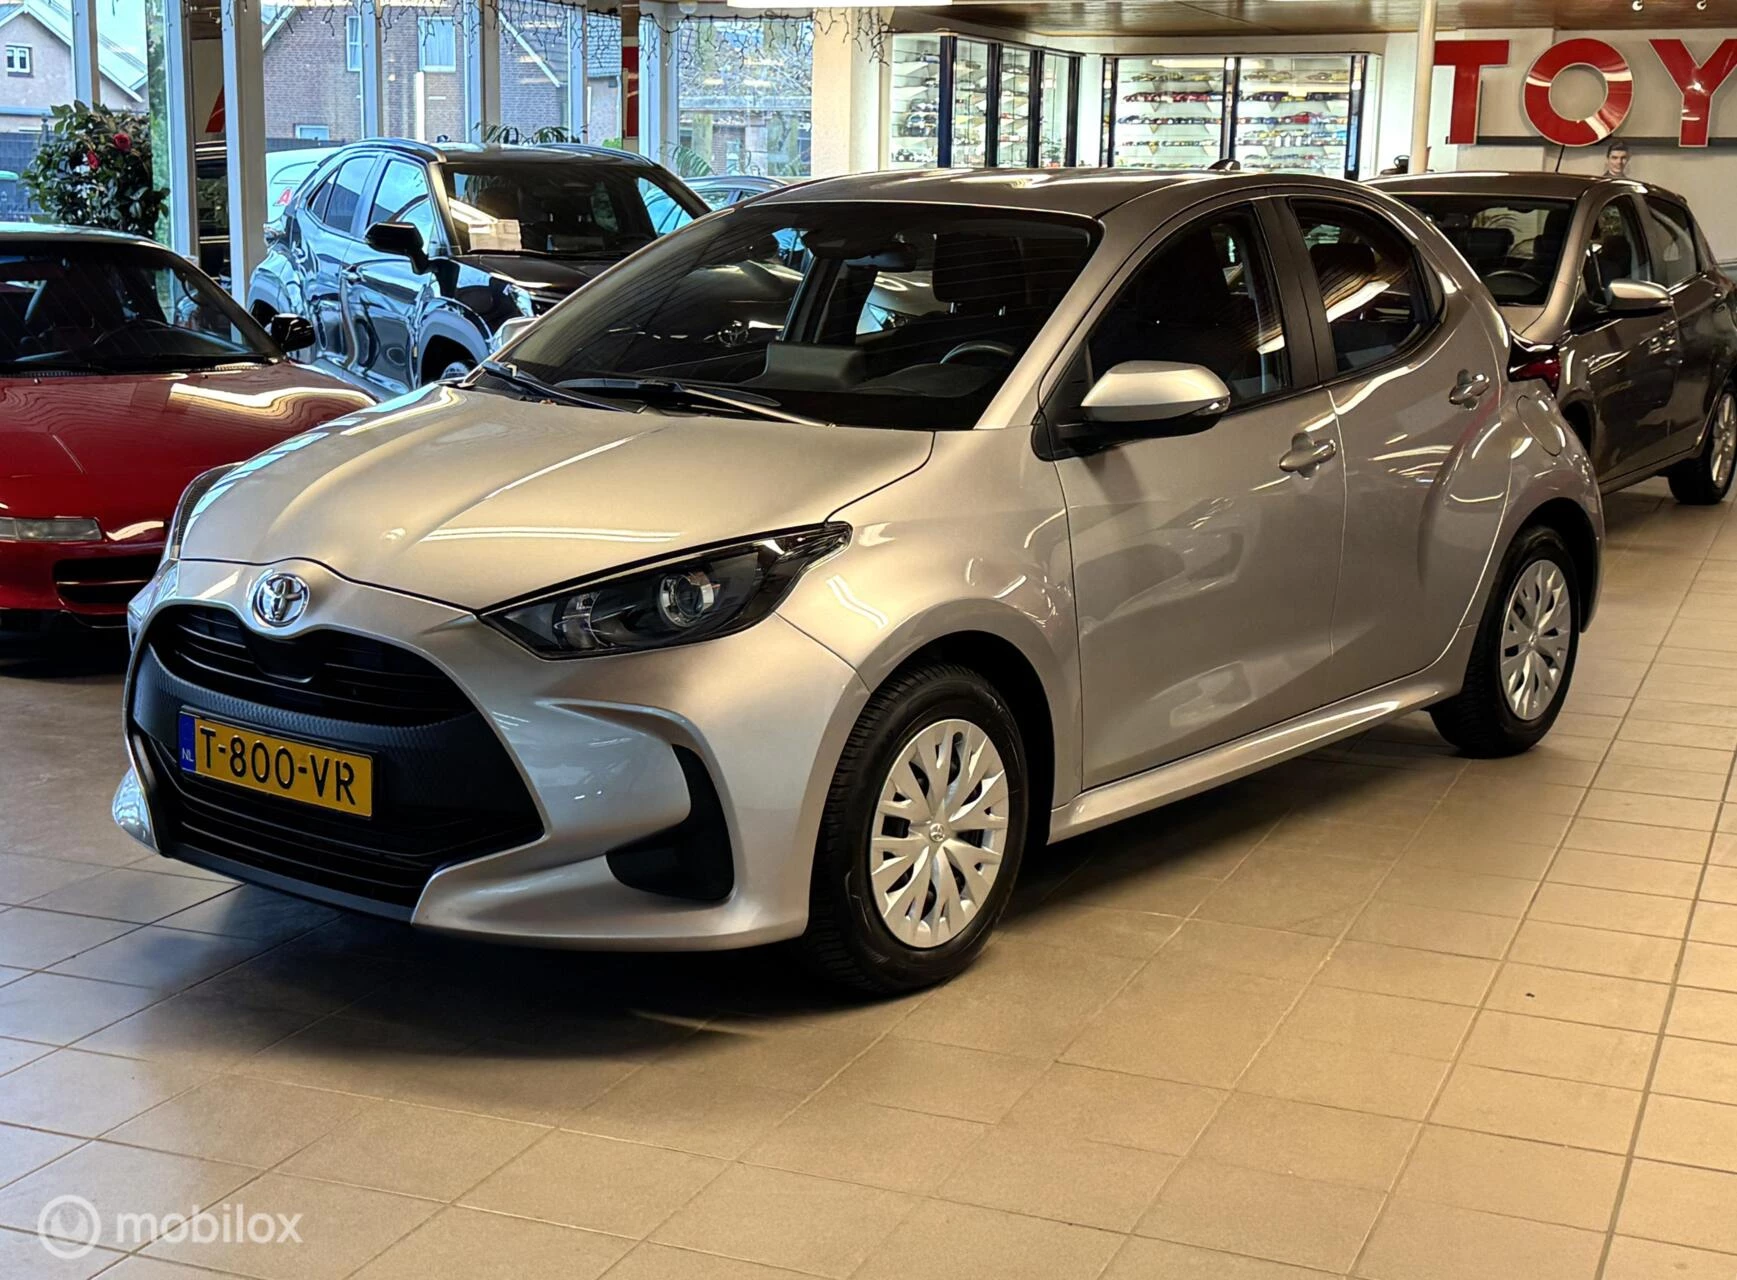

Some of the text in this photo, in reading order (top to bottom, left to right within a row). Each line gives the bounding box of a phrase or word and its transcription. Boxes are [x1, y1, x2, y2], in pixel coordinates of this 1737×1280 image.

[1434, 38, 1737, 147] TOY
[182, 726, 356, 806] NL T-800-VR
